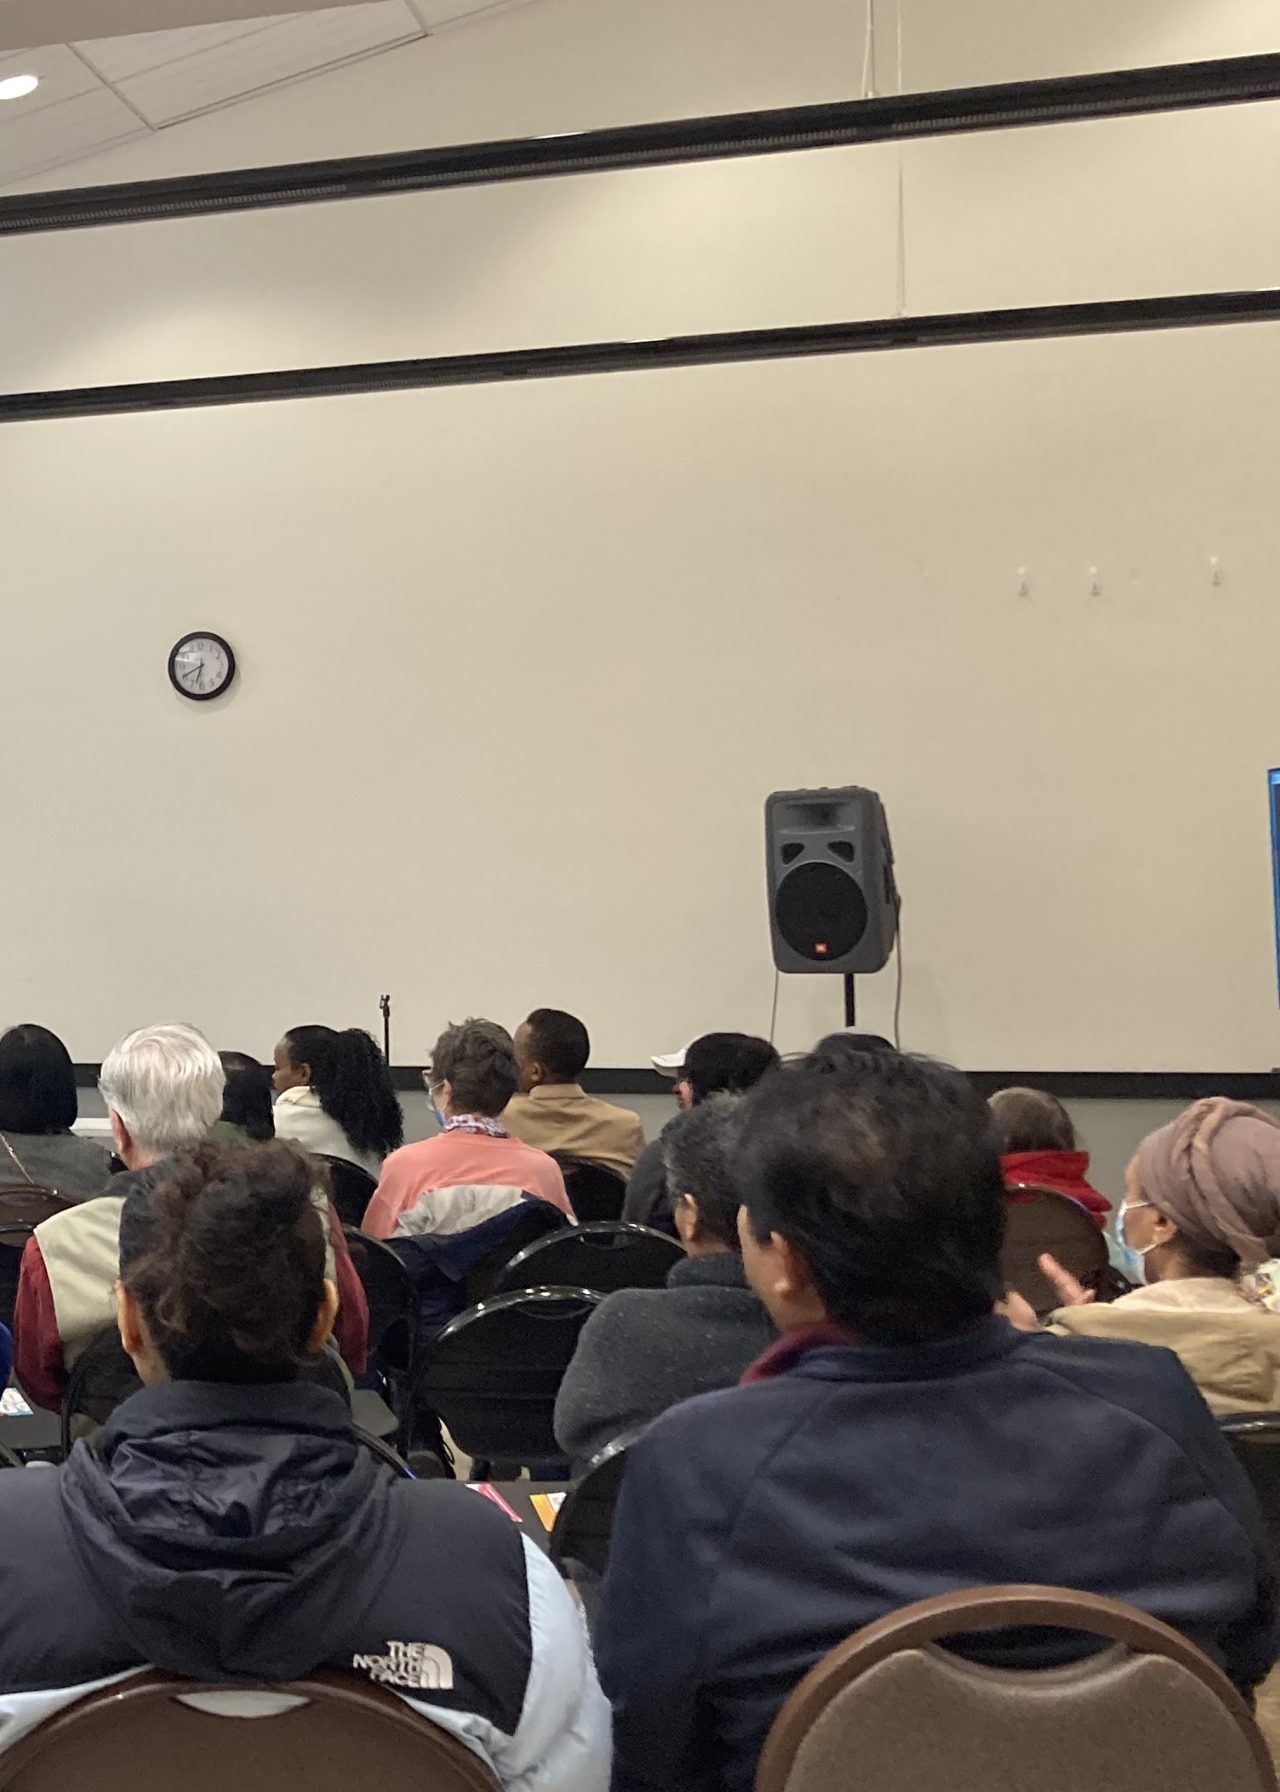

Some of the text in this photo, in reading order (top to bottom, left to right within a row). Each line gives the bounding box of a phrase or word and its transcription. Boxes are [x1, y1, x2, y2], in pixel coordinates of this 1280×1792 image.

[387, 1641, 424, 1657] THE
[353, 1653, 422, 1674] NORTH
[370, 1667, 421, 1688] FACE
